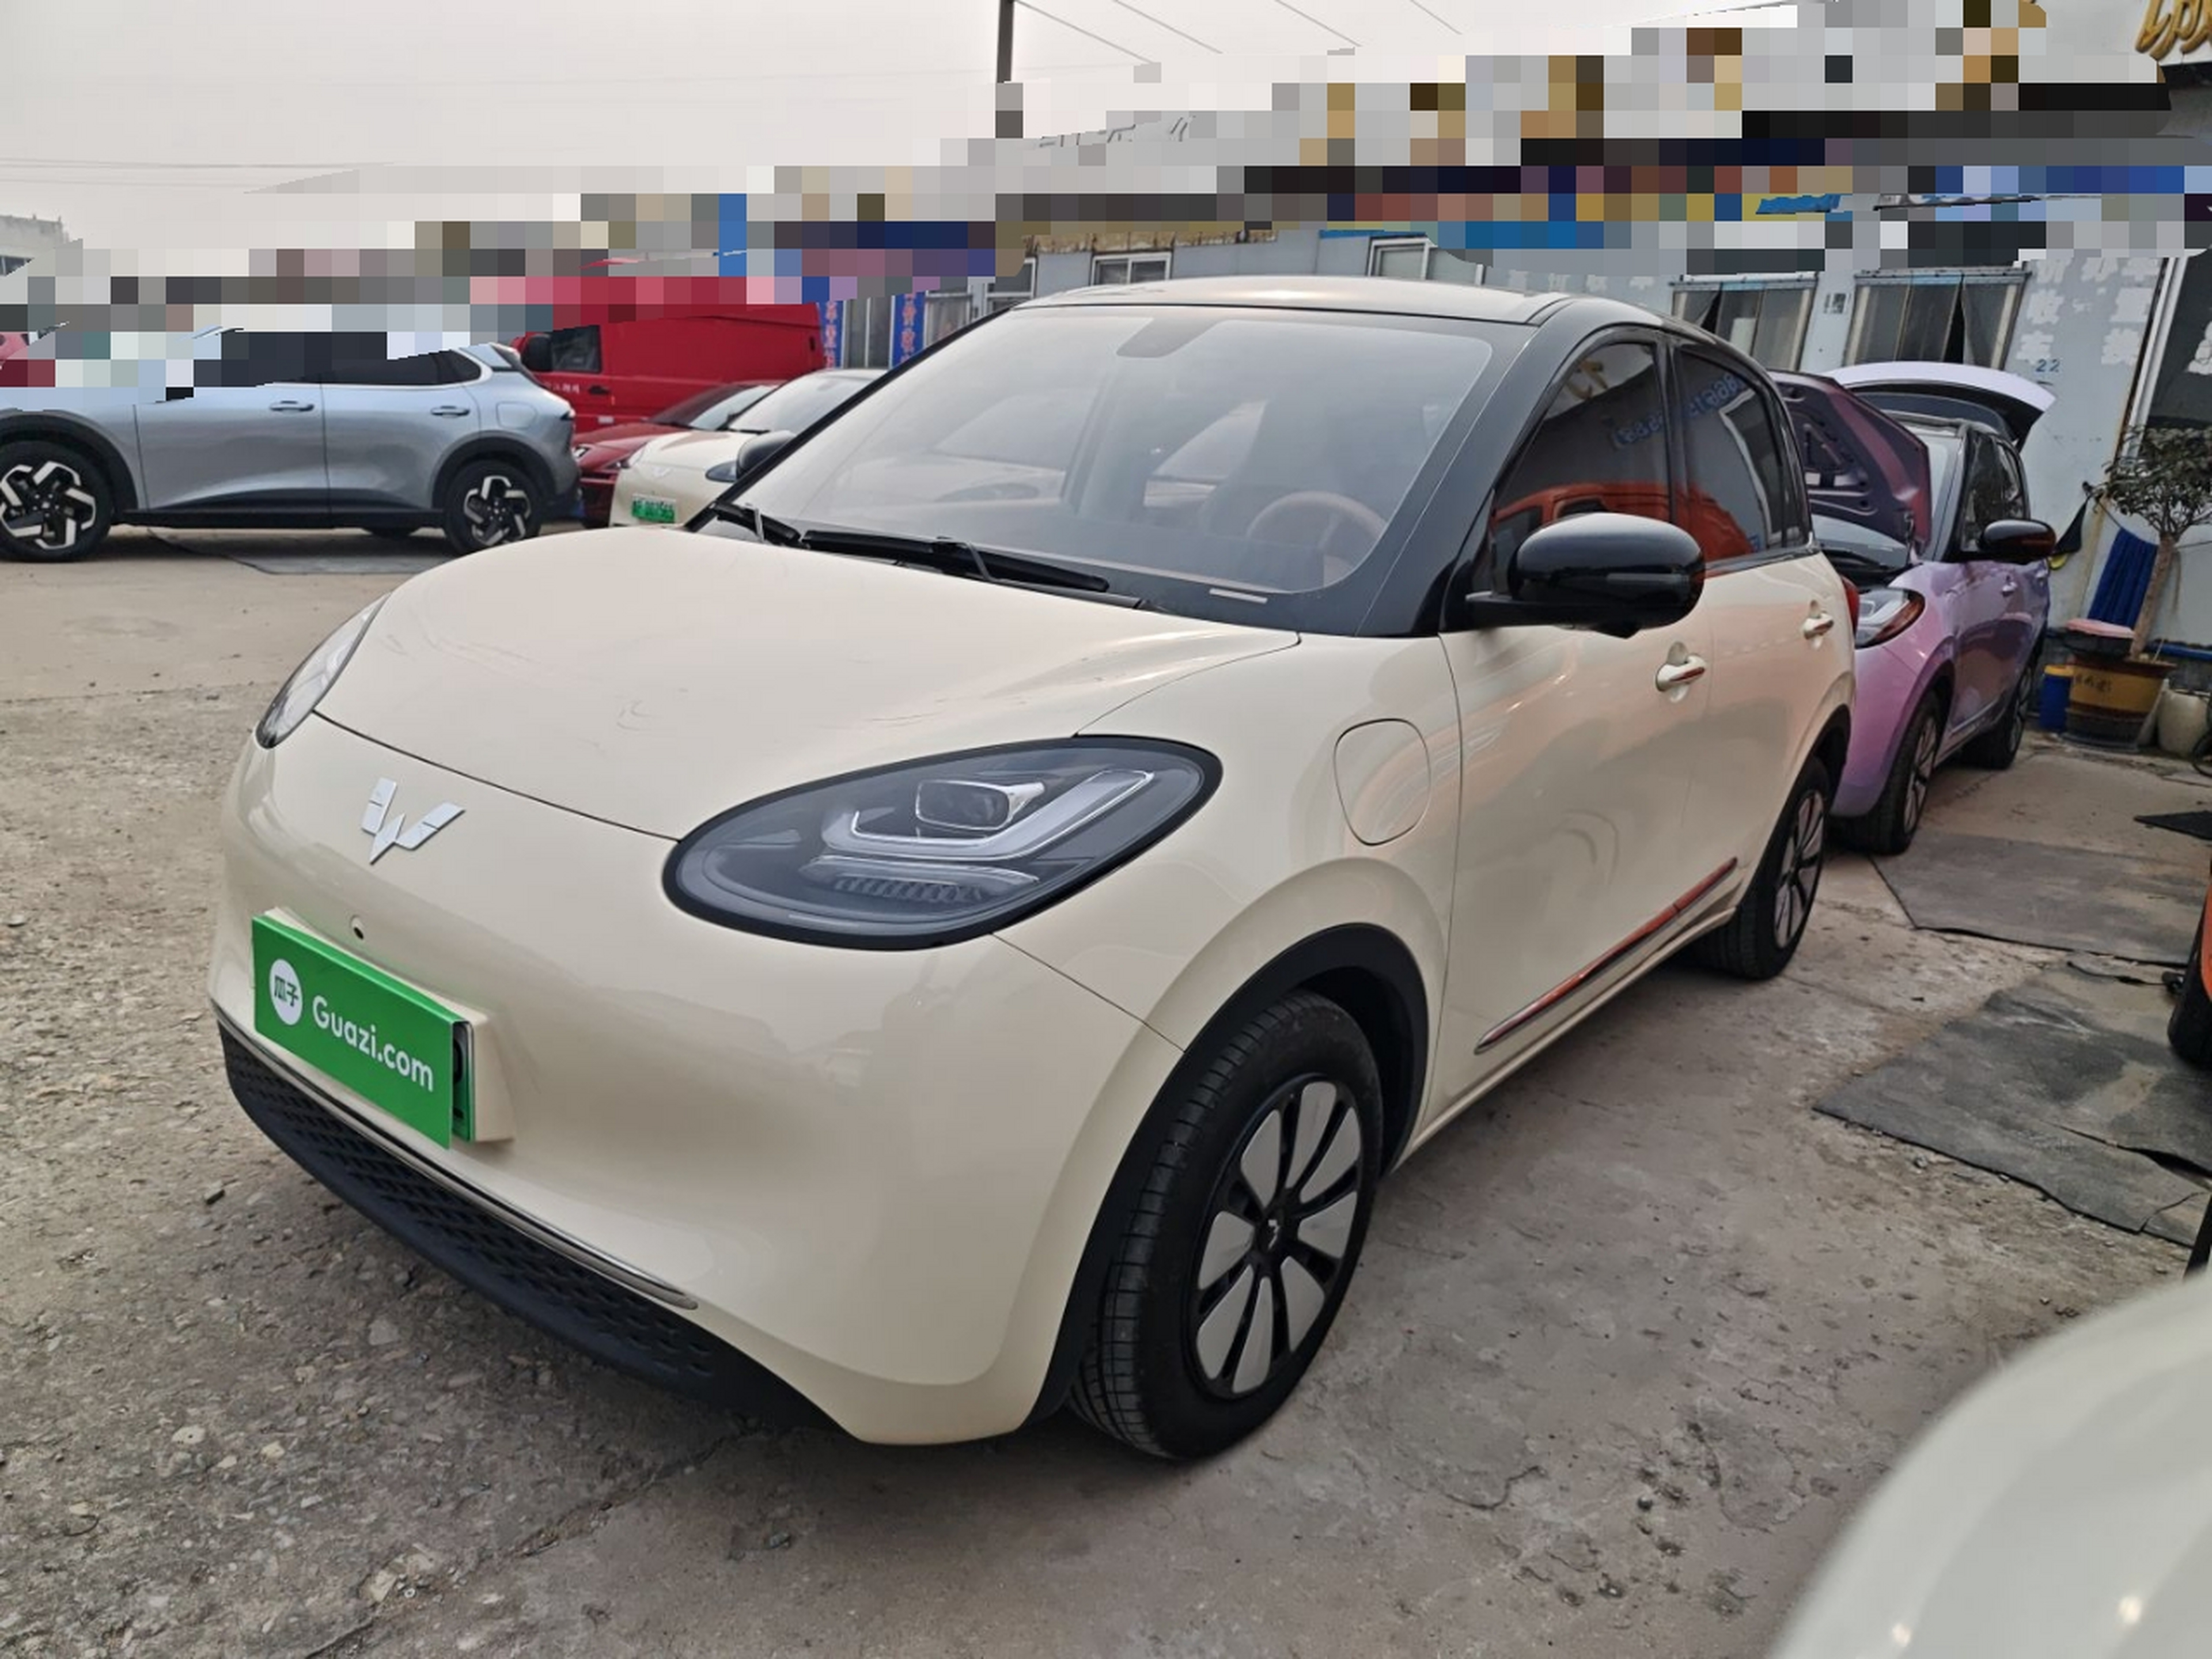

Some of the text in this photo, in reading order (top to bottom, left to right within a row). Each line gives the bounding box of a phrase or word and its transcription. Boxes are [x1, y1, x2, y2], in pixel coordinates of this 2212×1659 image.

[2035, 358, 2061, 372] 22
[274, 975, 299, 1007] 瓜子
[312, 995, 433, 1092] Guazi.com
